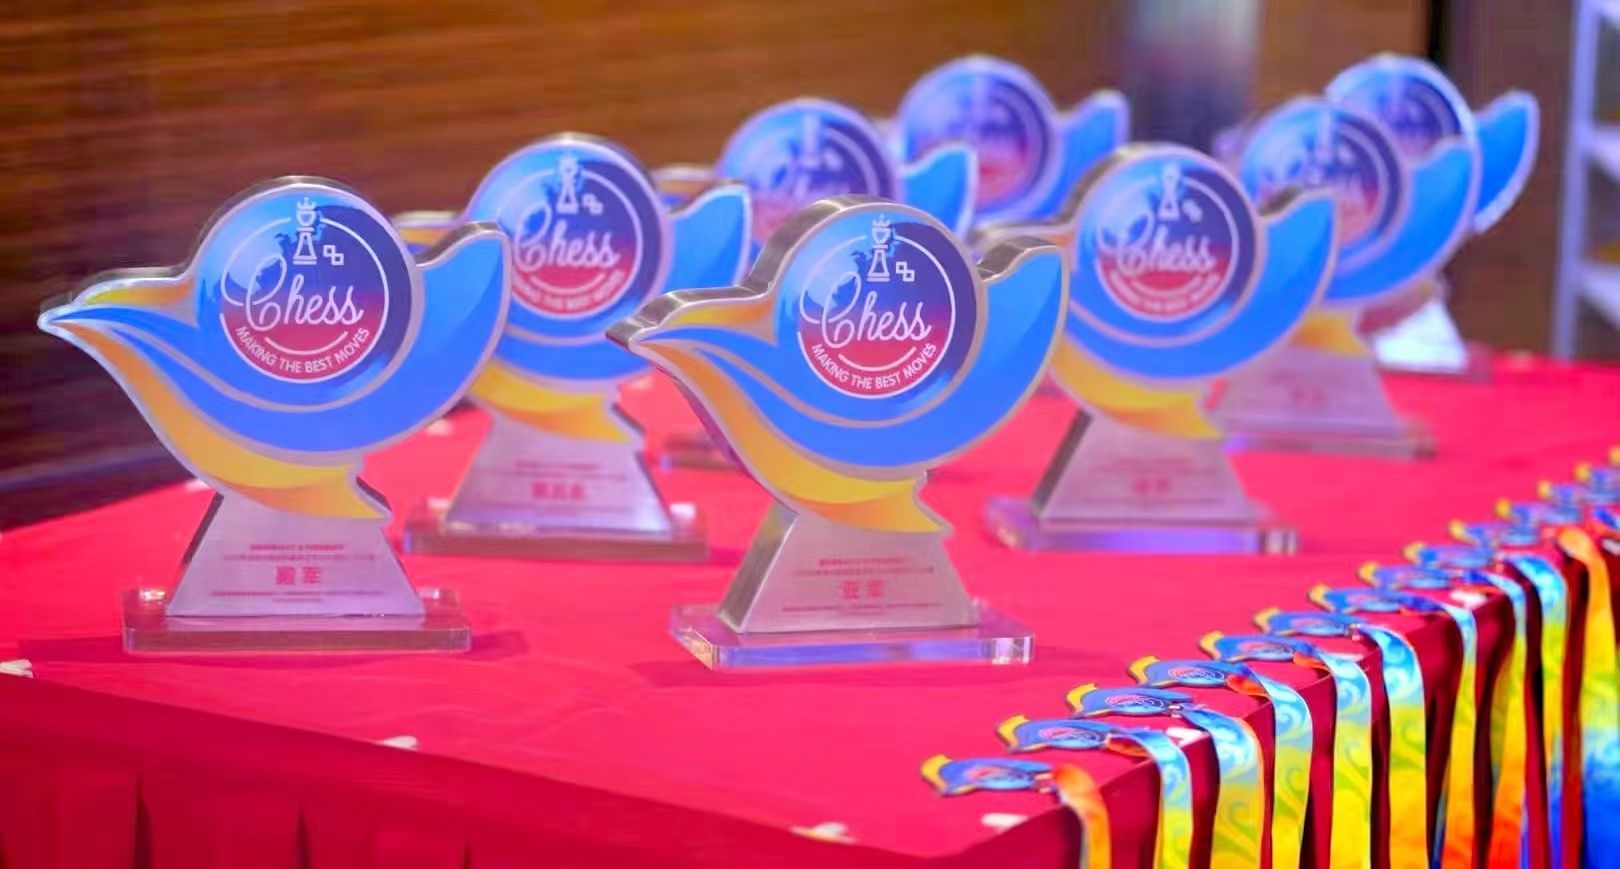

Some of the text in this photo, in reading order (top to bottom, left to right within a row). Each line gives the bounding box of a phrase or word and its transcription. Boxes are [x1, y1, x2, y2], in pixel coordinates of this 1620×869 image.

[514, 201, 621, 273] Chess
[222, 254, 364, 332] Chess
[801, 271, 932, 349] Chess
[236, 325, 370, 374] MAKING THE BEST MOVES
[812, 343, 937, 389] MAKING THE BEST MOVES
